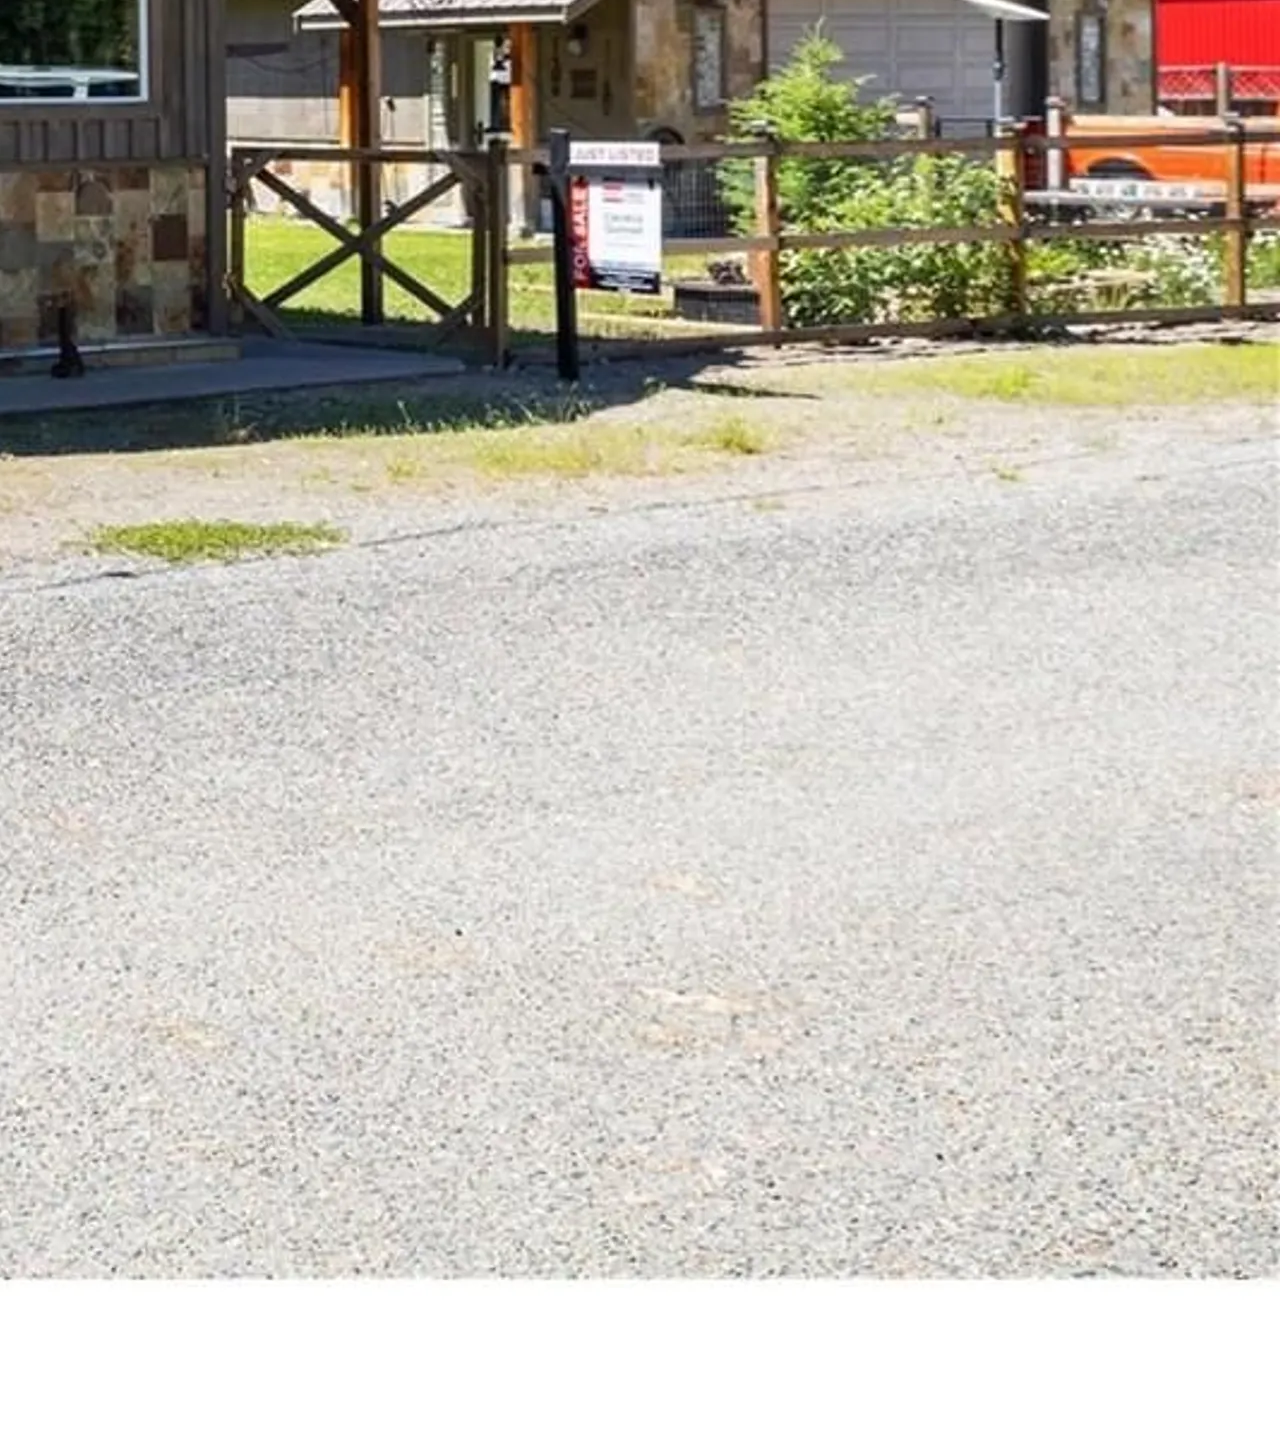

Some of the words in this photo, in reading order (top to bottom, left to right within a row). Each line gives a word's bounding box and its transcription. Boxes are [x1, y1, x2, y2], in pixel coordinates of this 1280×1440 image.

[574, 146, 606, 161] JUST
[608, 146, 655, 162] LISTED
[571, 187, 588, 237] SALE
[571, 243, 588, 281] FOR
